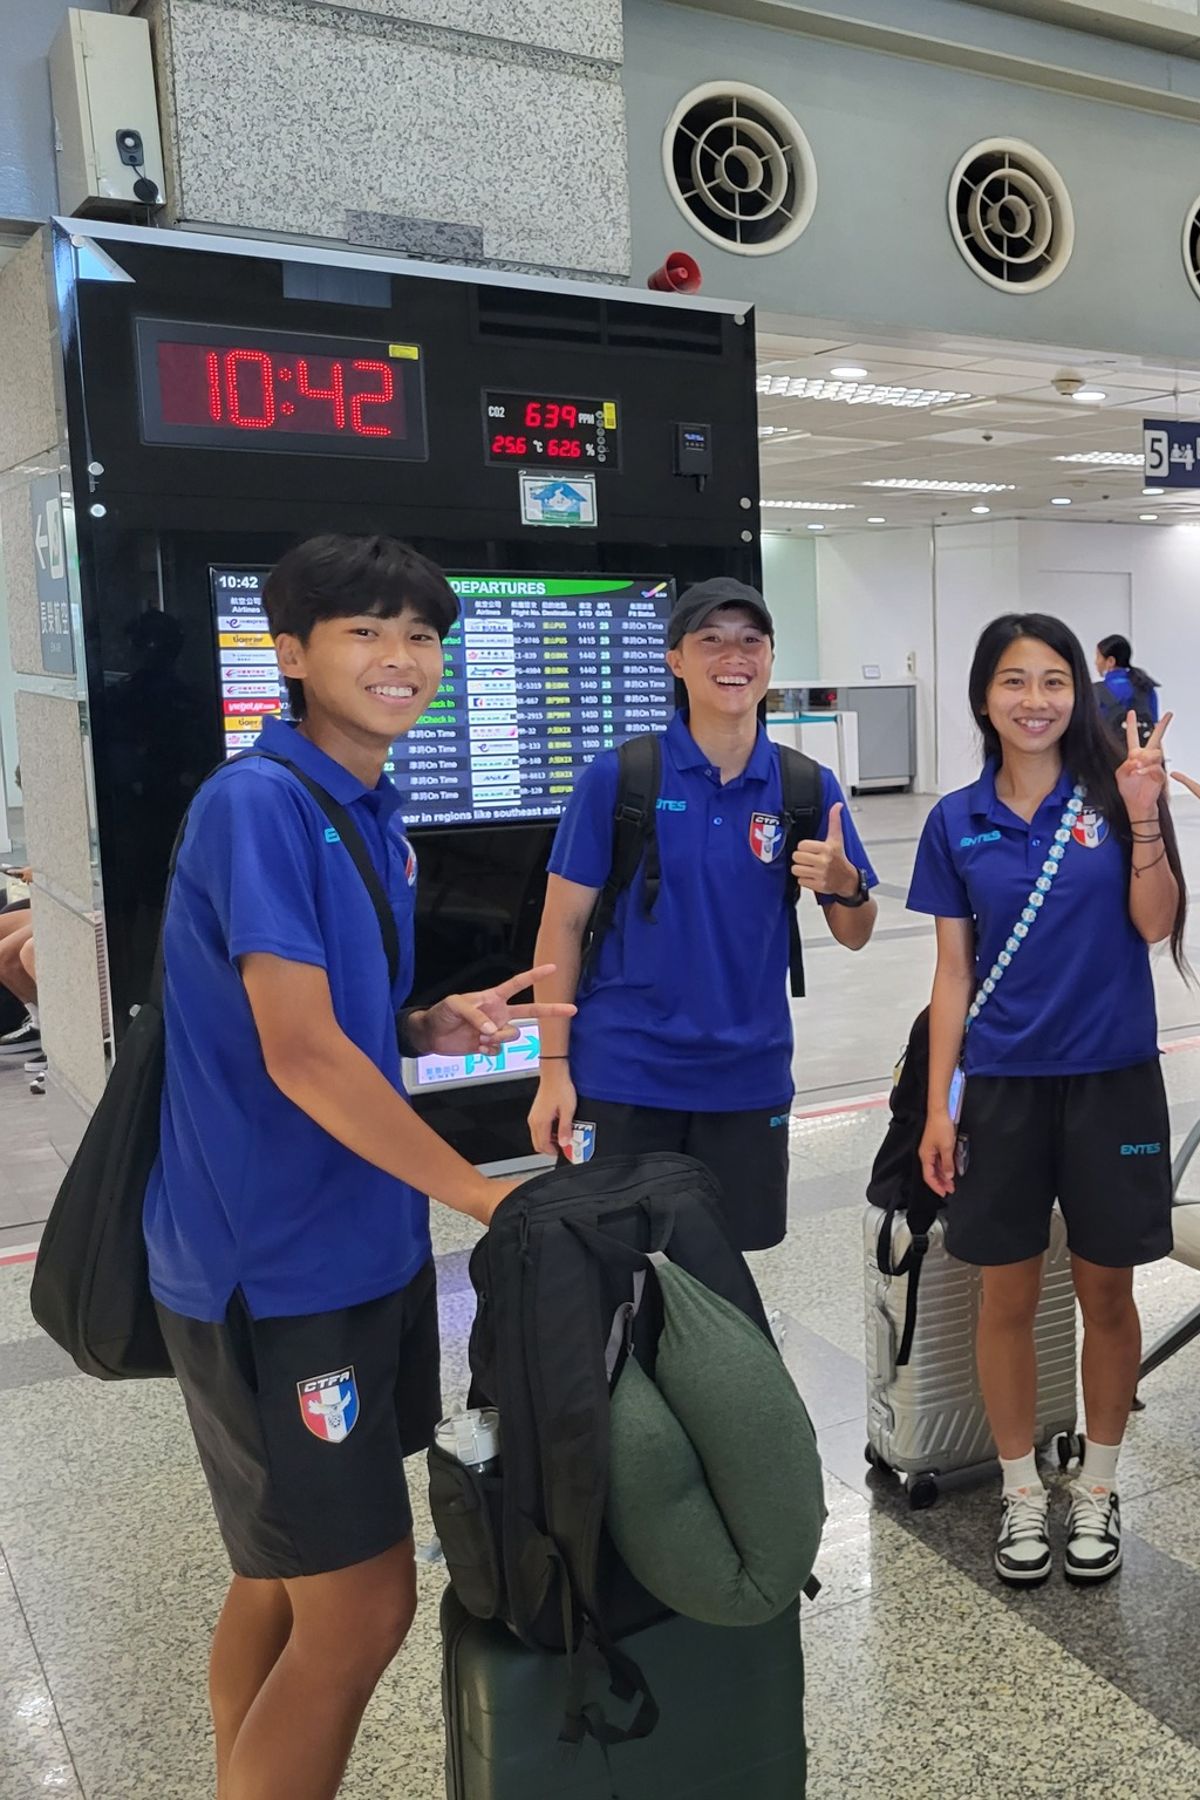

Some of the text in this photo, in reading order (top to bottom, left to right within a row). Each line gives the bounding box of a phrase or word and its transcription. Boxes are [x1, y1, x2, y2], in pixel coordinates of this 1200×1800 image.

[206, 348, 394, 437] 10:42
[488, 402, 595, 429] CO2 639 PPM
[1150, 437, 1163, 469] 5
[219, 575, 259, 588] 10:42
[451, 580, 546, 595] DEPARTURES
[648, 636, 664, 644] Time
[648, 651, 665, 659] Time
[649, 680, 666, 688] Time
[650, 709, 667, 717] Time
[437, 729, 456, 737] Time
[438, 745, 457, 753] Time
[439, 760, 458, 768] Time
[439, 776, 458, 784] Time
[440, 791, 459, 799] Time
[422, 813, 432, 822] in
[434, 811, 472, 823] regions
[474, 810, 492, 819] like
[493, 806, 541, 818] southeast
[543, 805, 561, 815] and
[960, 829, 1001, 848] ENTES
[1120, 1142, 1161, 1156] ENTES
[303, 1370, 351, 1393] CTFA
